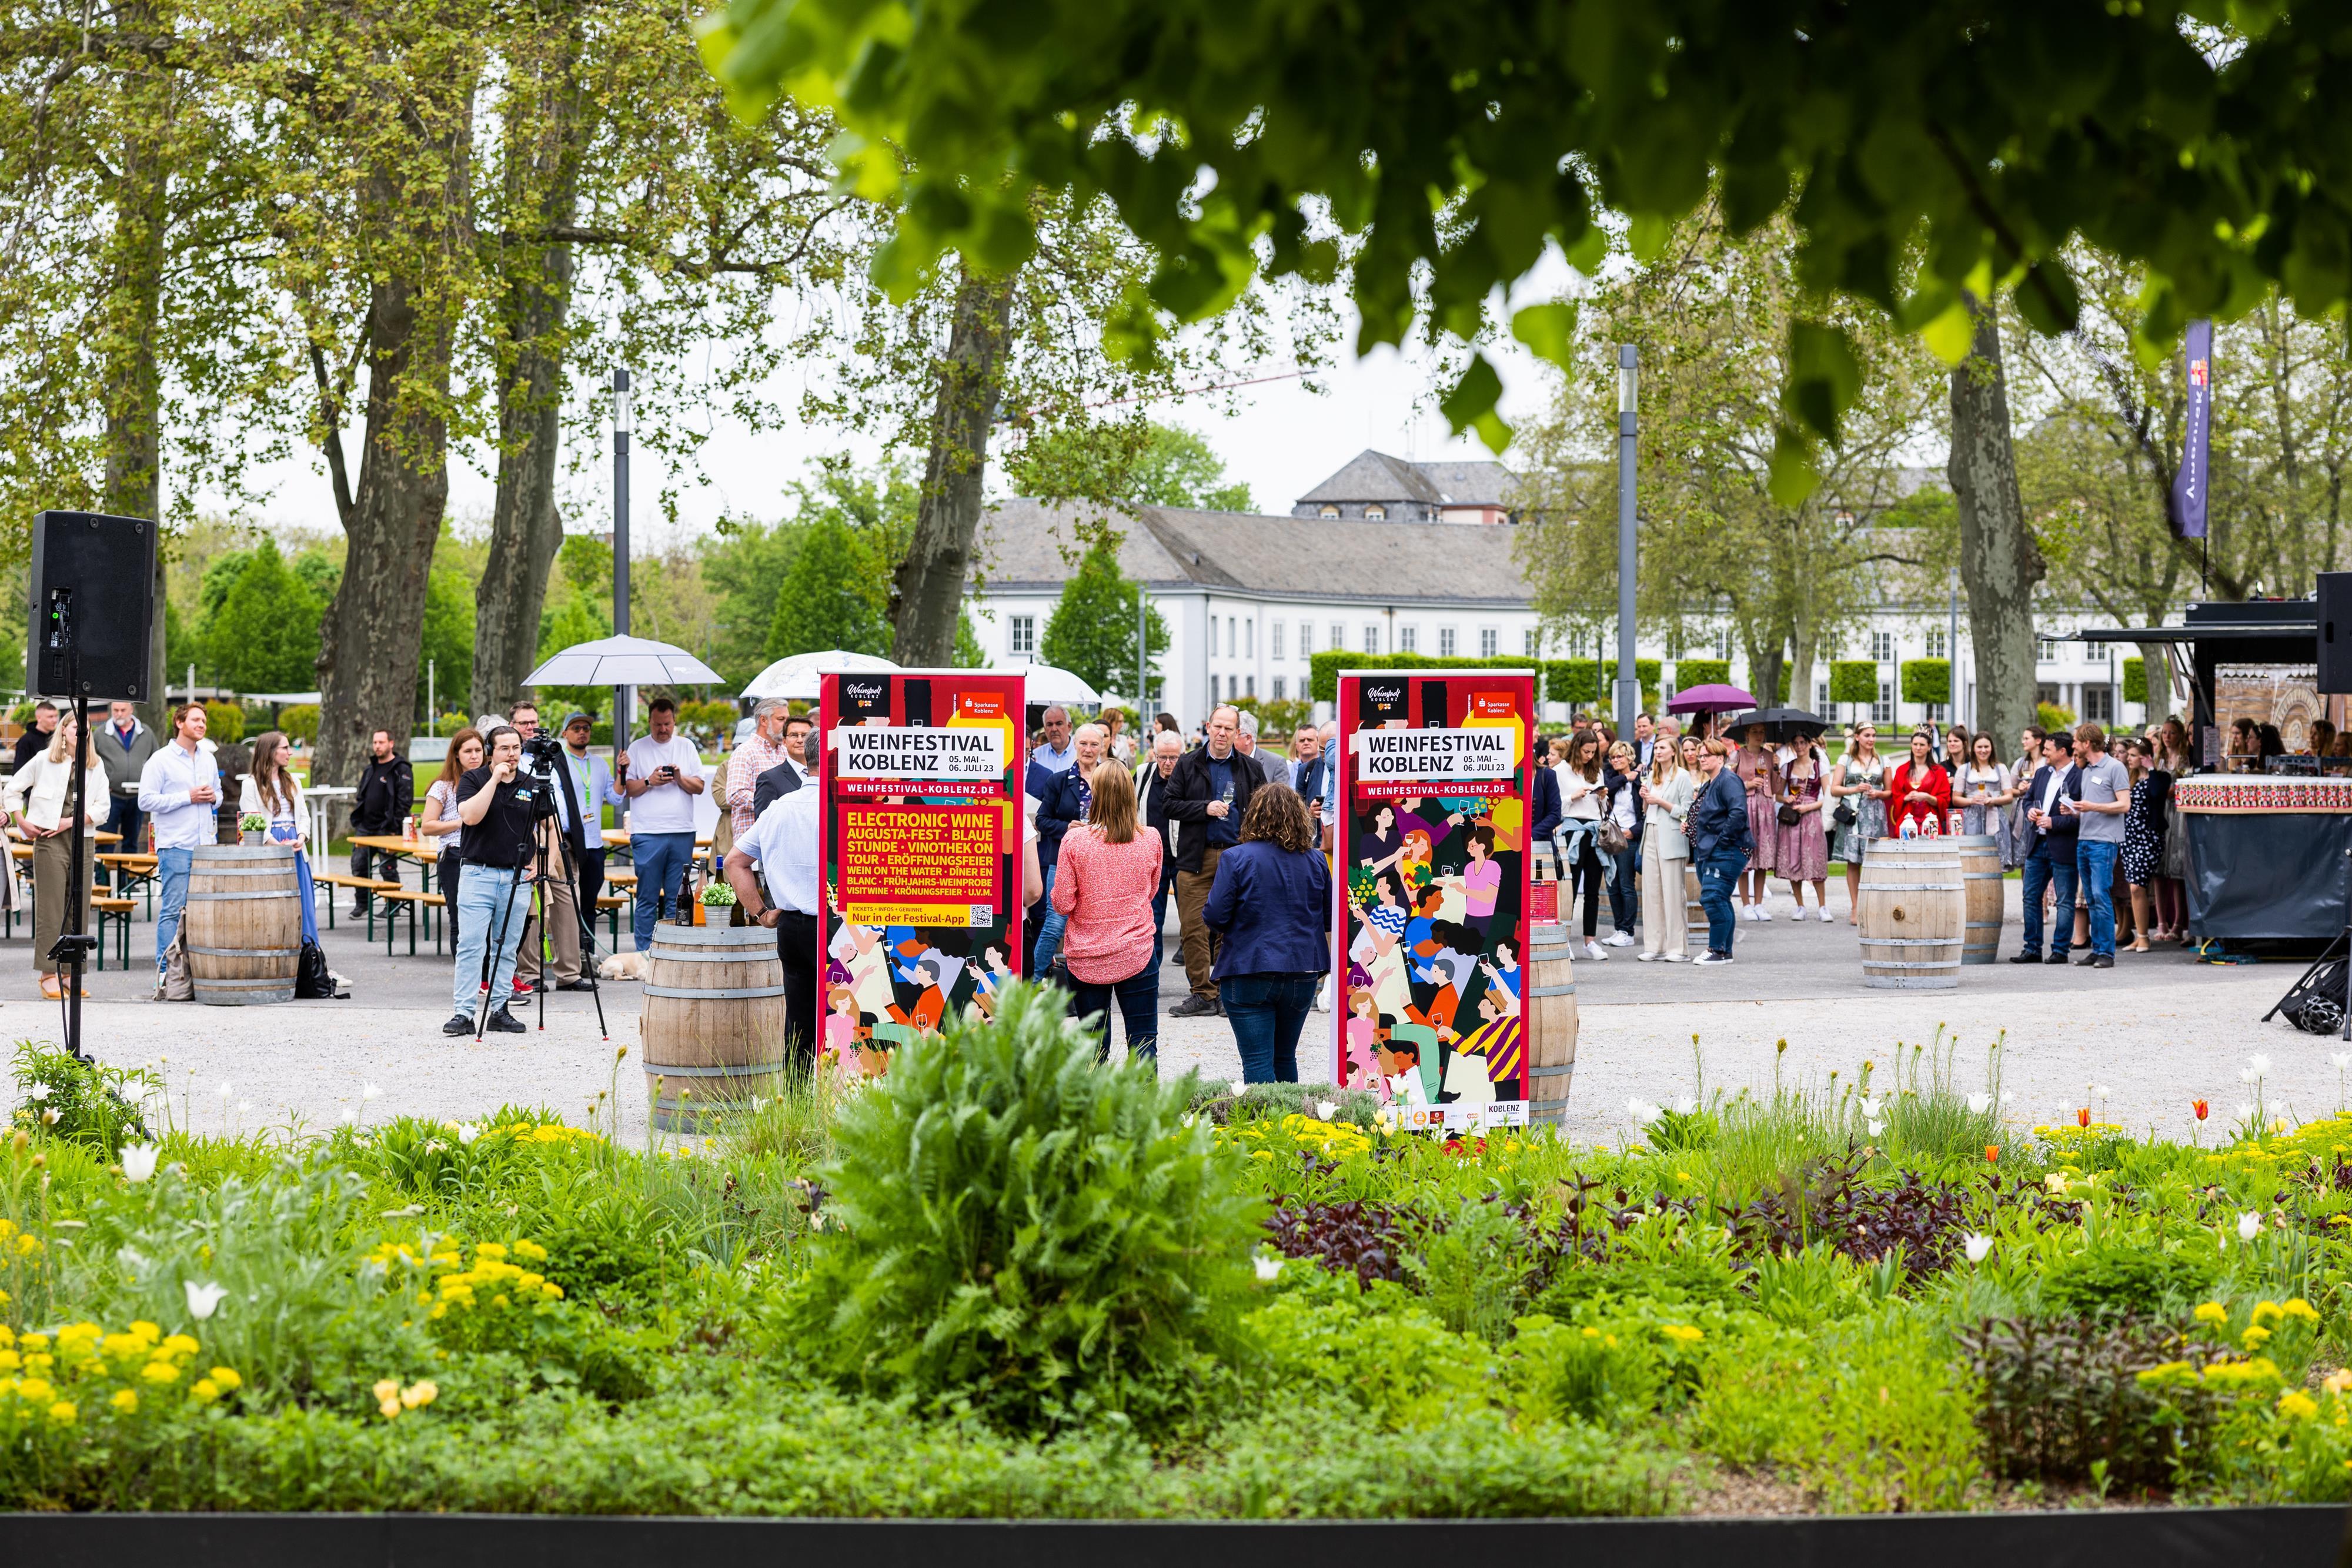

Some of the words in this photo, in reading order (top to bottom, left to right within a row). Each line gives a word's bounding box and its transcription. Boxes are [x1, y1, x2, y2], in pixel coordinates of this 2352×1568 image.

[847, 683, 883, 695] Weinstadt
[1368, 686, 1401, 698] Weinstadt
[848, 734, 994, 751] WEINFESTIVAL
[1369, 735, 1505, 753] WEINFESTIVAL
[848, 754, 938, 771] KOBLENZ
[1369, 755, 1454, 773] KOBLENZ
[847, 784, 994, 794] WEINFESTIVAL-KOBLENZ.DE
[1368, 785, 1505, 795] WEINFESTIVAL-KOBLENZ.DE
[847, 812, 948, 827] ELECTRONIC
[951, 813, 993, 828] WINE
[847, 828, 942, 840] AUGUSTA-FEST
[952, 829, 993, 841] BLAUE
[847, 841, 897, 852] STUNDE
[908, 842, 971, 854] VINOTHEK
[974, 842, 993, 854] ON
[847, 855, 878, 864] TOUR
[887, 853, 993, 866] ERÖFFNUNGSFEIER
[847, 866, 871, 875] WEIN
[874, 867, 887, 875] ON
[890, 867, 908, 875] THE
[910, 867, 942, 875] WATER
[949, 866, 978, 876] DÎNER
[980, 868, 993, 877] EN
[847, 877, 877, 885] BLANC
[884, 876, 992, 887] FRÜHJAHRS-WEINPROBE
[847, 887, 888, 895] VISITWINE
[894, 887, 962, 895] KRÖNUNGSFEIER
[853, 913, 870, 922] Nur
[873, 913, 882, 922] in
[884, 913, 901, 922] der
[904, 914, 964, 925] Festival-App
